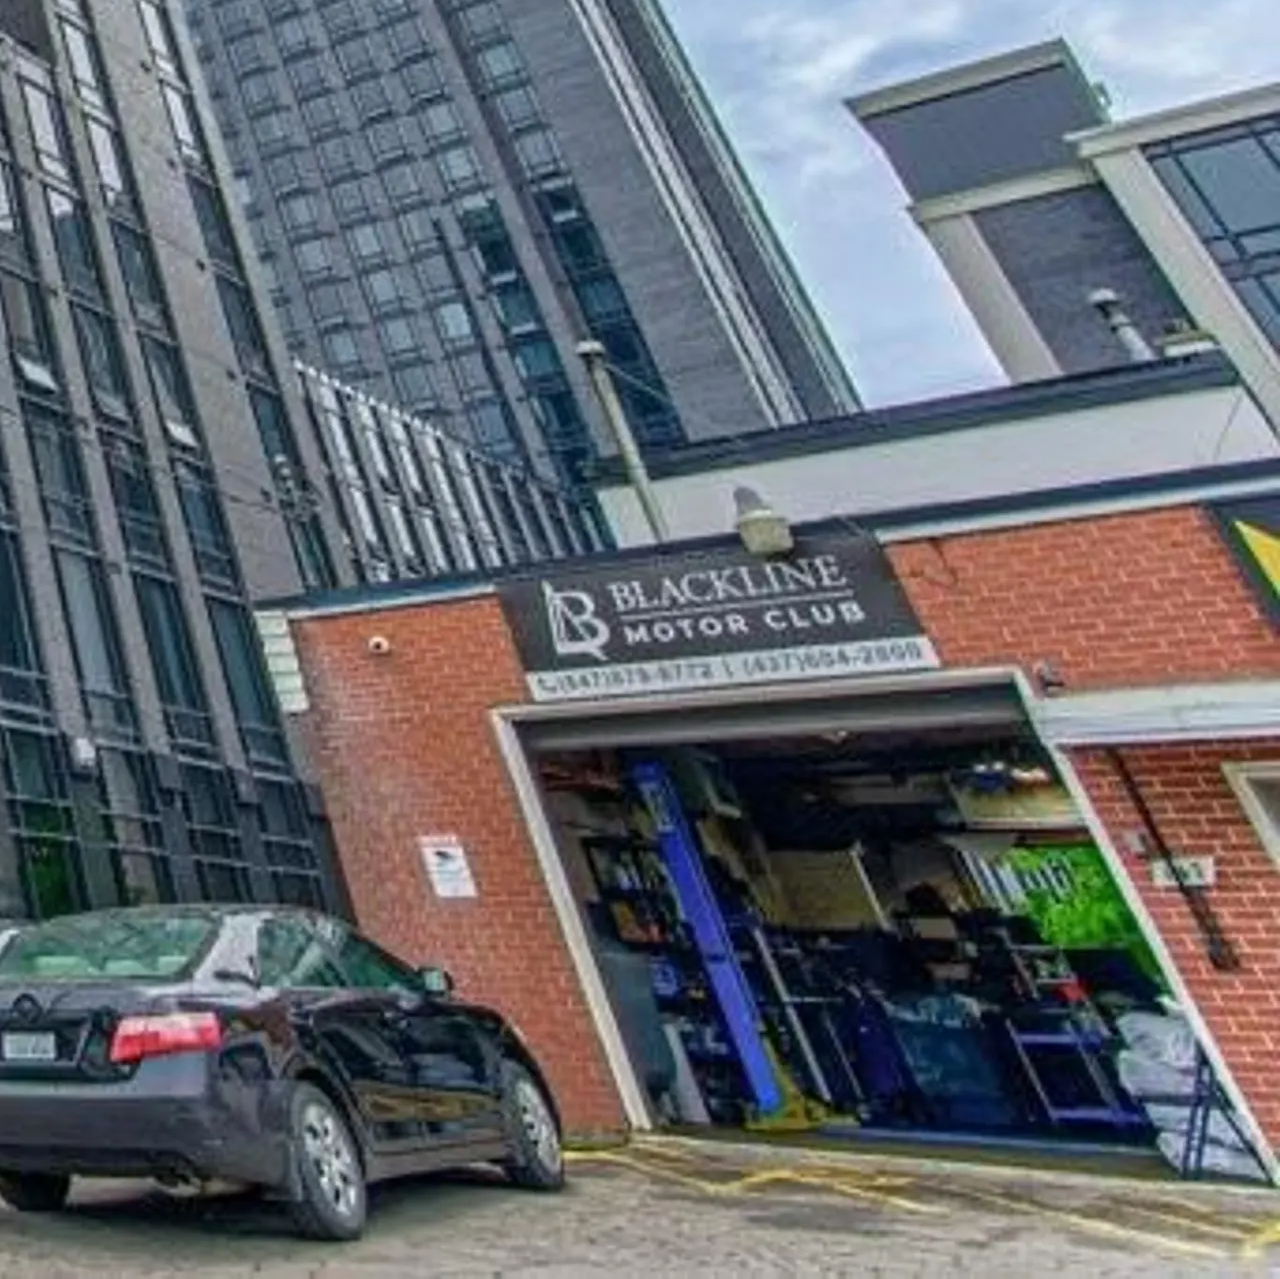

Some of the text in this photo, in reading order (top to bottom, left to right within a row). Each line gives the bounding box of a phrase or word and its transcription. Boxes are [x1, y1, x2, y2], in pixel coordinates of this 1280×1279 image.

[606, 554, 848, 613] BLACKLINE
[622, 599, 866, 646] MOTOR CLUB
